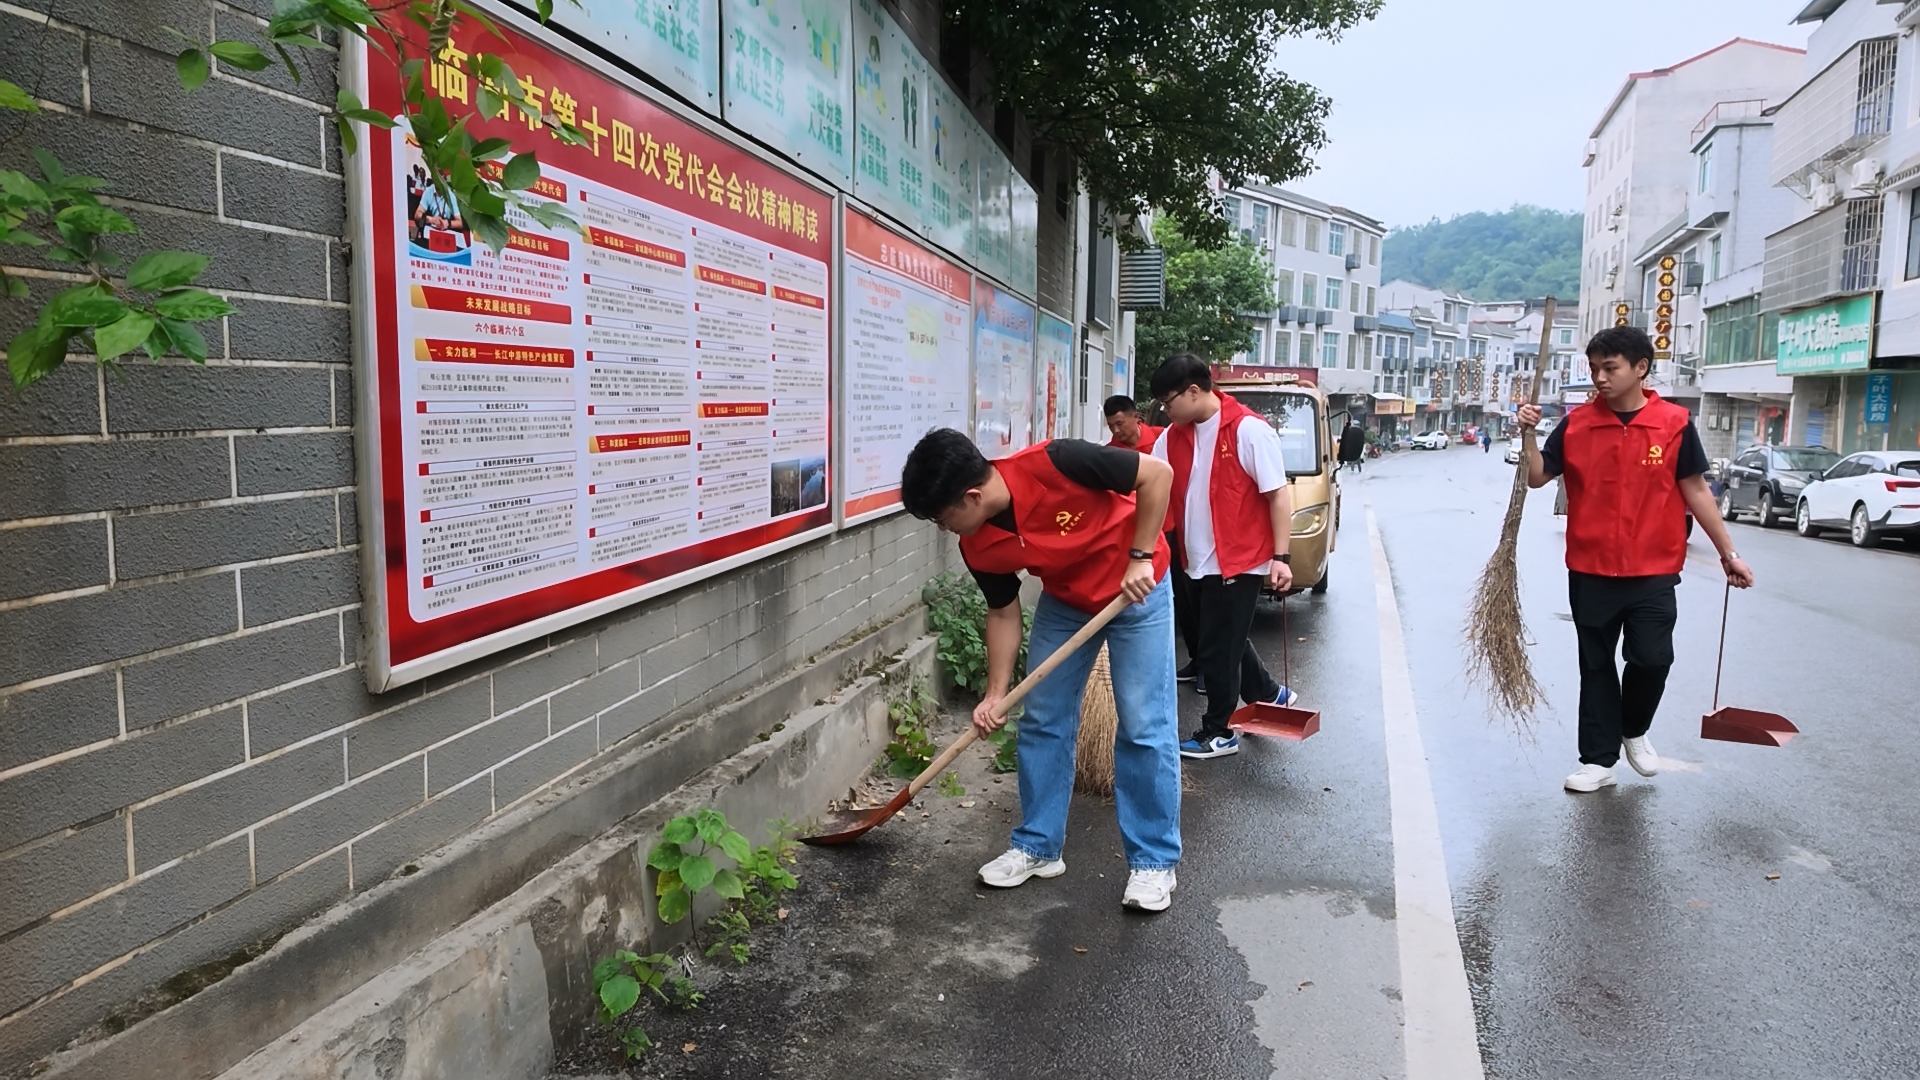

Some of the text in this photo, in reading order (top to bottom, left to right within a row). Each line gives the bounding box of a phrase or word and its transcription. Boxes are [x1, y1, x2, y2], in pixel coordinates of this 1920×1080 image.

[735, 27, 784, 84] 文明有序
[736, 60, 785, 116] 礼让三分
[466, 297, 531, 316] 未来发展战略目标
[475, 323, 525, 337] 六个临湘六个区
